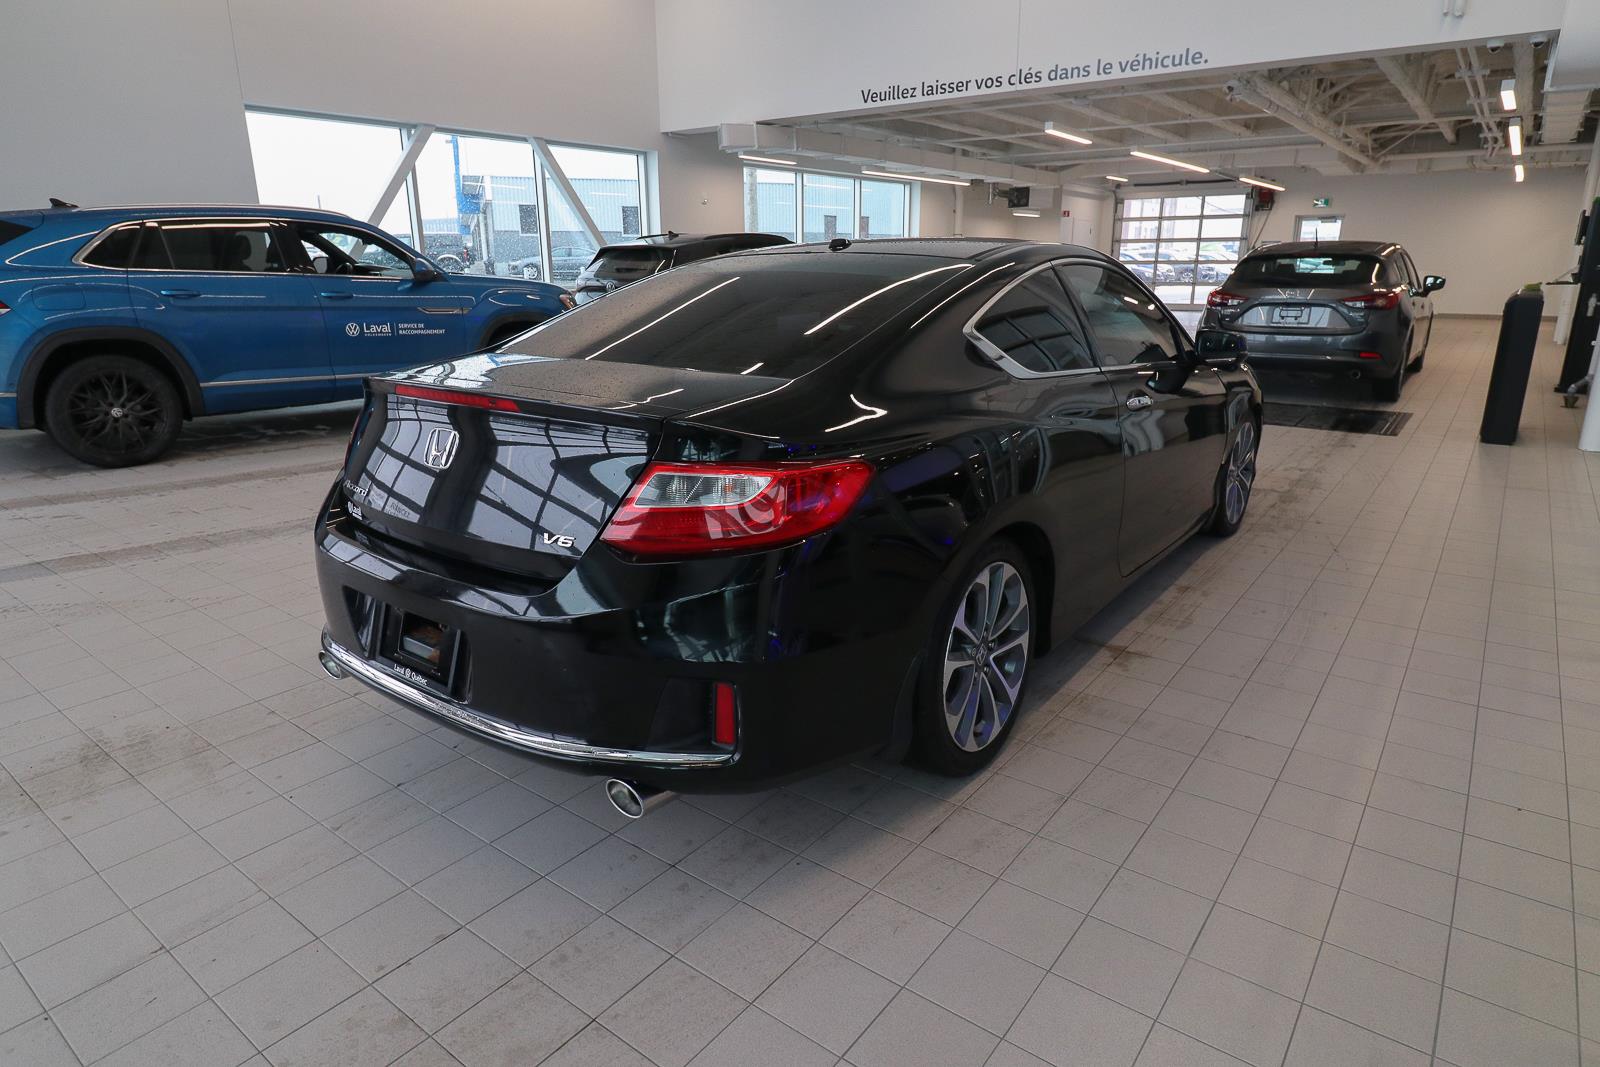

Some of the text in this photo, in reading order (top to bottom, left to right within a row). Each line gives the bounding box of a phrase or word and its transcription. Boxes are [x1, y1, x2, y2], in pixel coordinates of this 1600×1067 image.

[860, 47, 1209, 104] Veuillez laisser vos clés dans le véhicule.
[363, 322, 392, 333] Laval
[543, 532, 576, 548] V6
